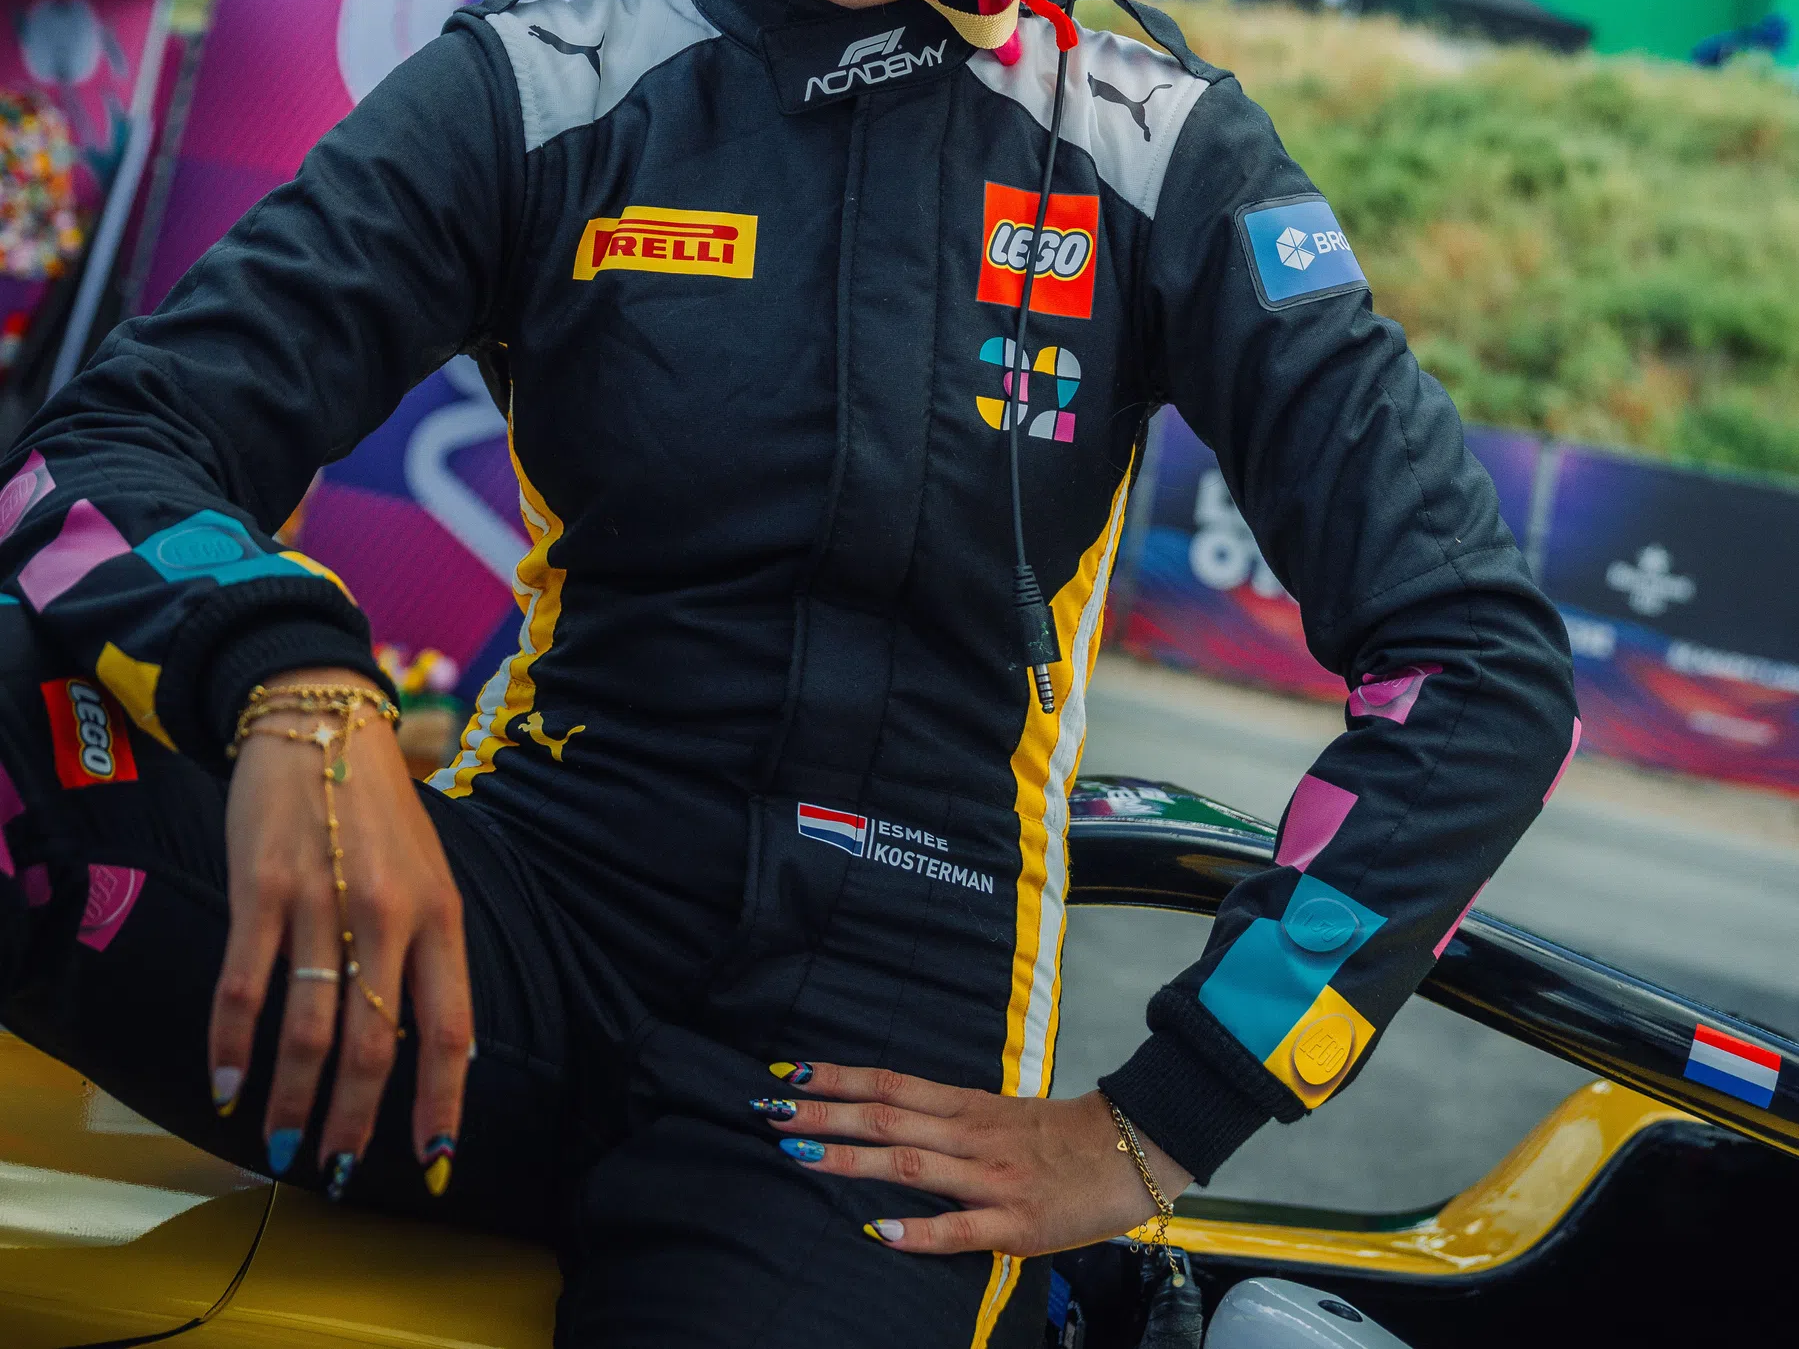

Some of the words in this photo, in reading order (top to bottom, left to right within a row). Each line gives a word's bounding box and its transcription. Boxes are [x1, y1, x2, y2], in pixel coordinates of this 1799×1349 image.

[804, 39, 947, 101] ACADEMY
[838, 26, 905, 67] F1
[592, 219, 738, 267] PRELLI
[989, 223, 1090, 279] LEGO
[70, 683, 113, 776] LEGO
[878, 820, 949, 852] ESMEE
[873, 842, 994, 894] KOSTERMAN
[1298, 1027, 1346, 1073] LEGO
